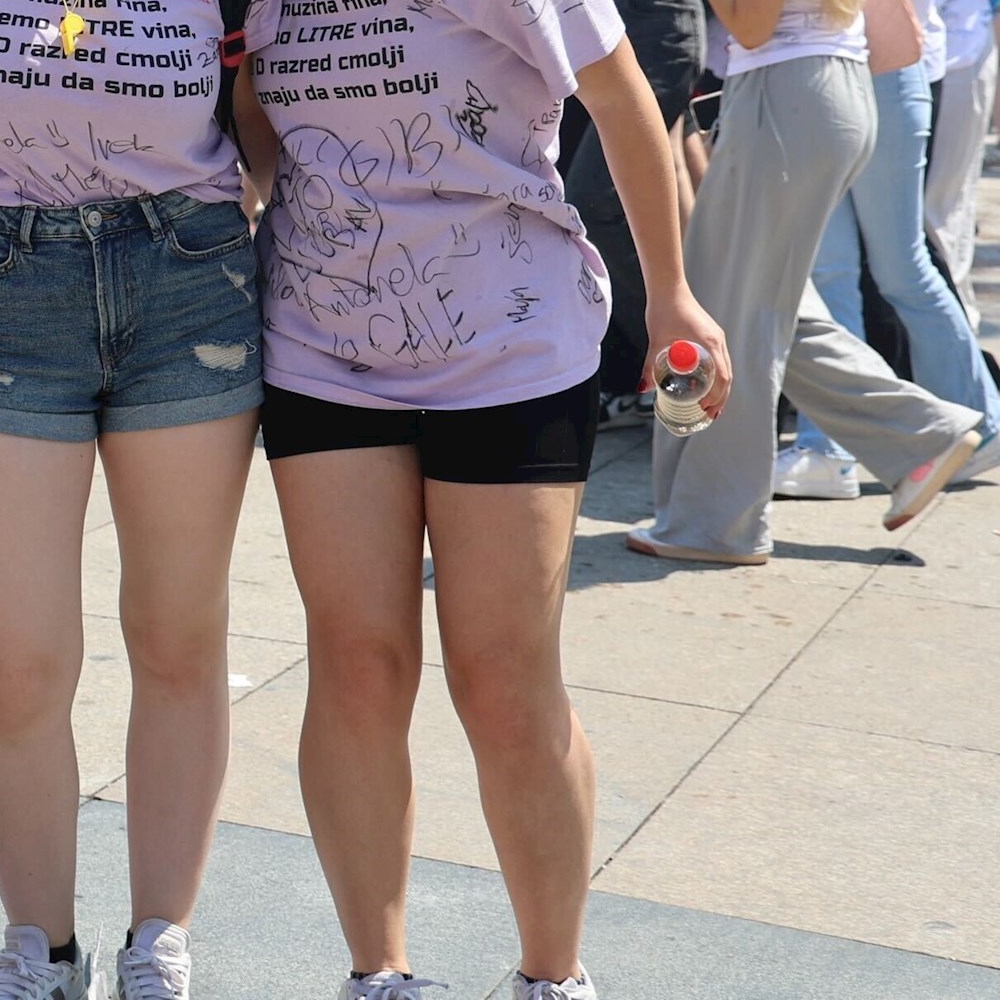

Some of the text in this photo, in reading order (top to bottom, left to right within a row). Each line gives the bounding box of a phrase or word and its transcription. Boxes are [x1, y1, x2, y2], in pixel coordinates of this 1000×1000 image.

[60, 17, 135, 38] TRE
[141, 21, 197, 41] vina,
[297, 21, 357, 43] LITRE
[361, 16, 416, 37] vina,
[269, 53, 332, 75] razred
[338, 44, 406, 71] cmolji
[61, 71, 95, 92] da
[104, 80, 165, 99] smo
[174, 74, 214, 98] bolji
[257, 71, 440, 107] znaju da smo bolji
